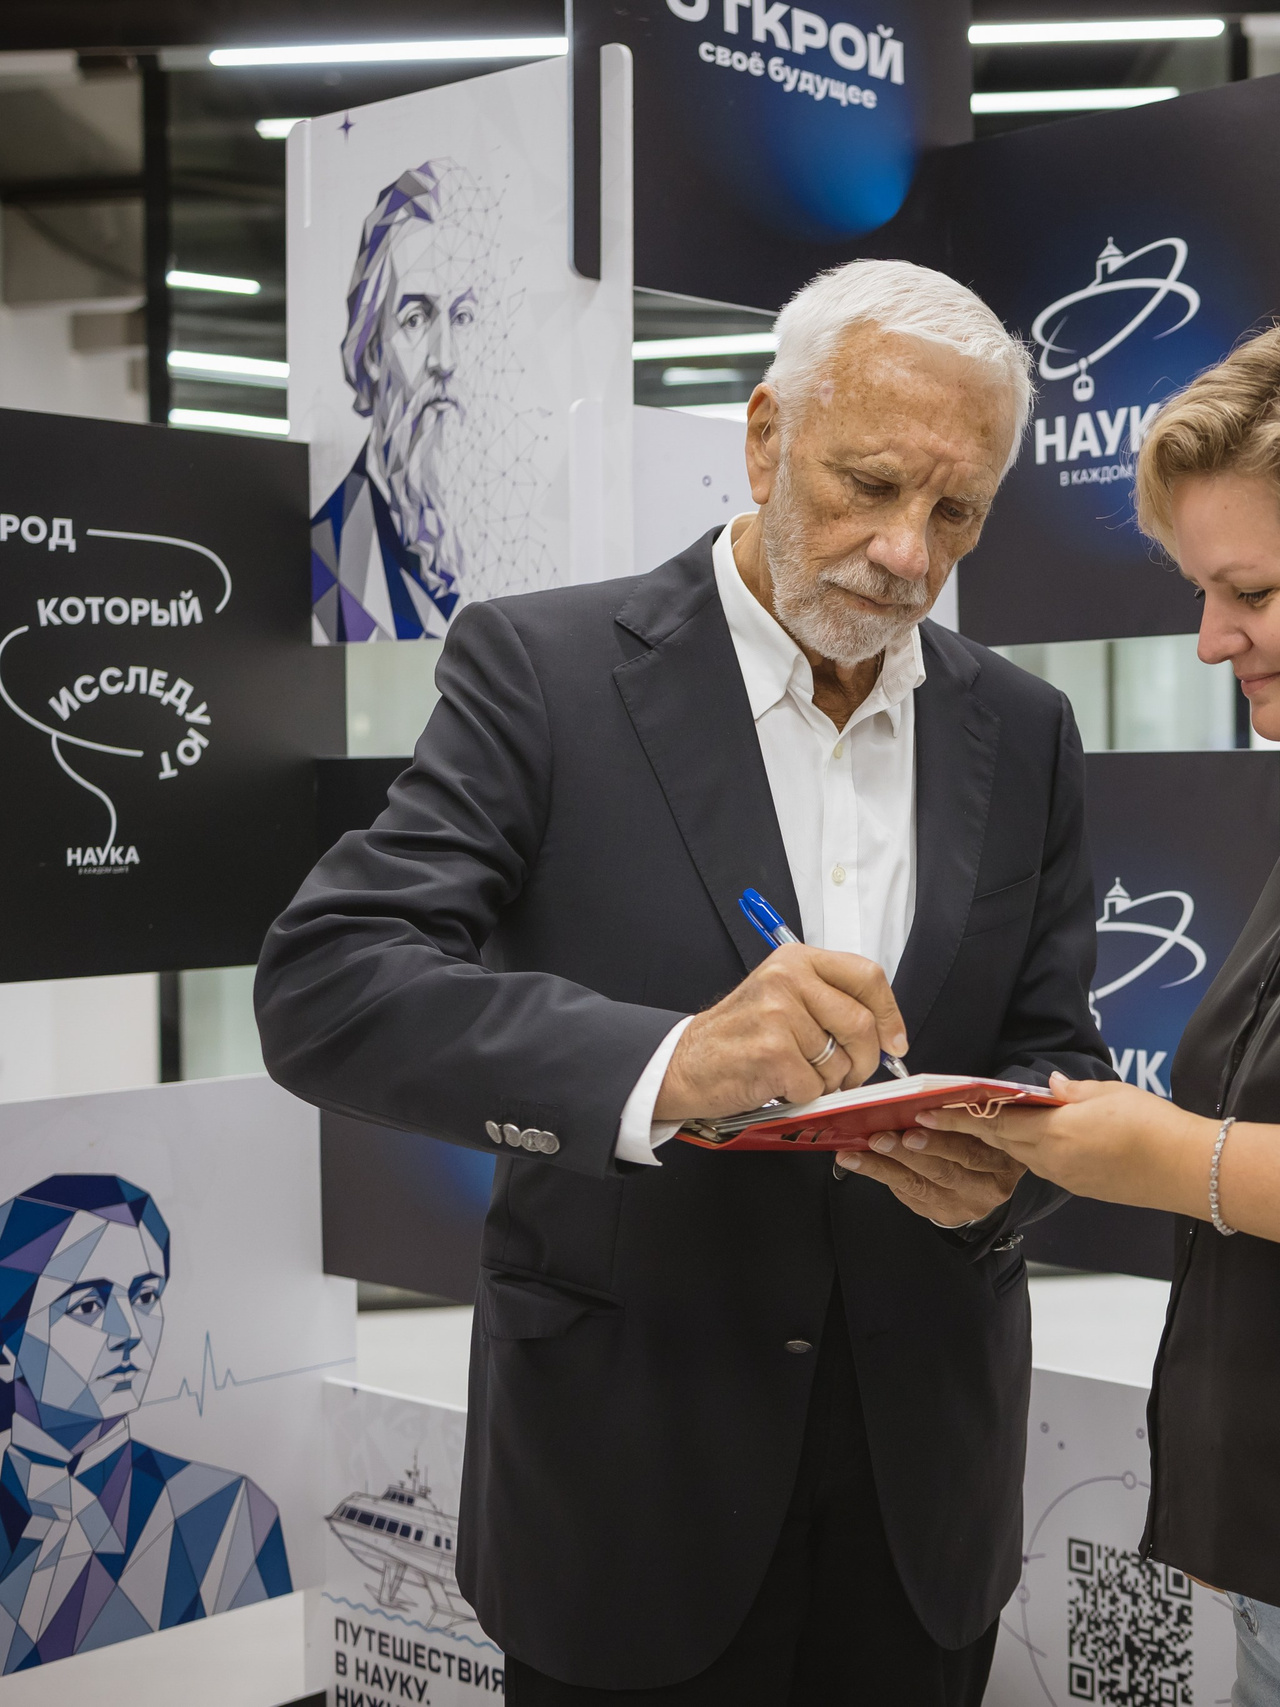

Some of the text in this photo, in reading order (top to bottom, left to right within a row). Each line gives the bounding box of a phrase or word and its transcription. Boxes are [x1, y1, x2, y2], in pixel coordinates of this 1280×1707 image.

[698, 41, 878, 109] своё будущее
[1059, 464, 1134, 487] В КАЖДОМ
[0, 513, 76, 553] РОД
[37, 590, 203, 626] КОТОРЫЙ
[48, 666, 212, 779] ИССЛЕДУЮТ
[66, 845, 141, 867] НАУКА
[1108, 1046, 1172, 1098] УК
[335, 1618, 504, 1694] ПУТЕШЕСТВИЯ
[335, 1651, 431, 1706] В НАУКУ.
